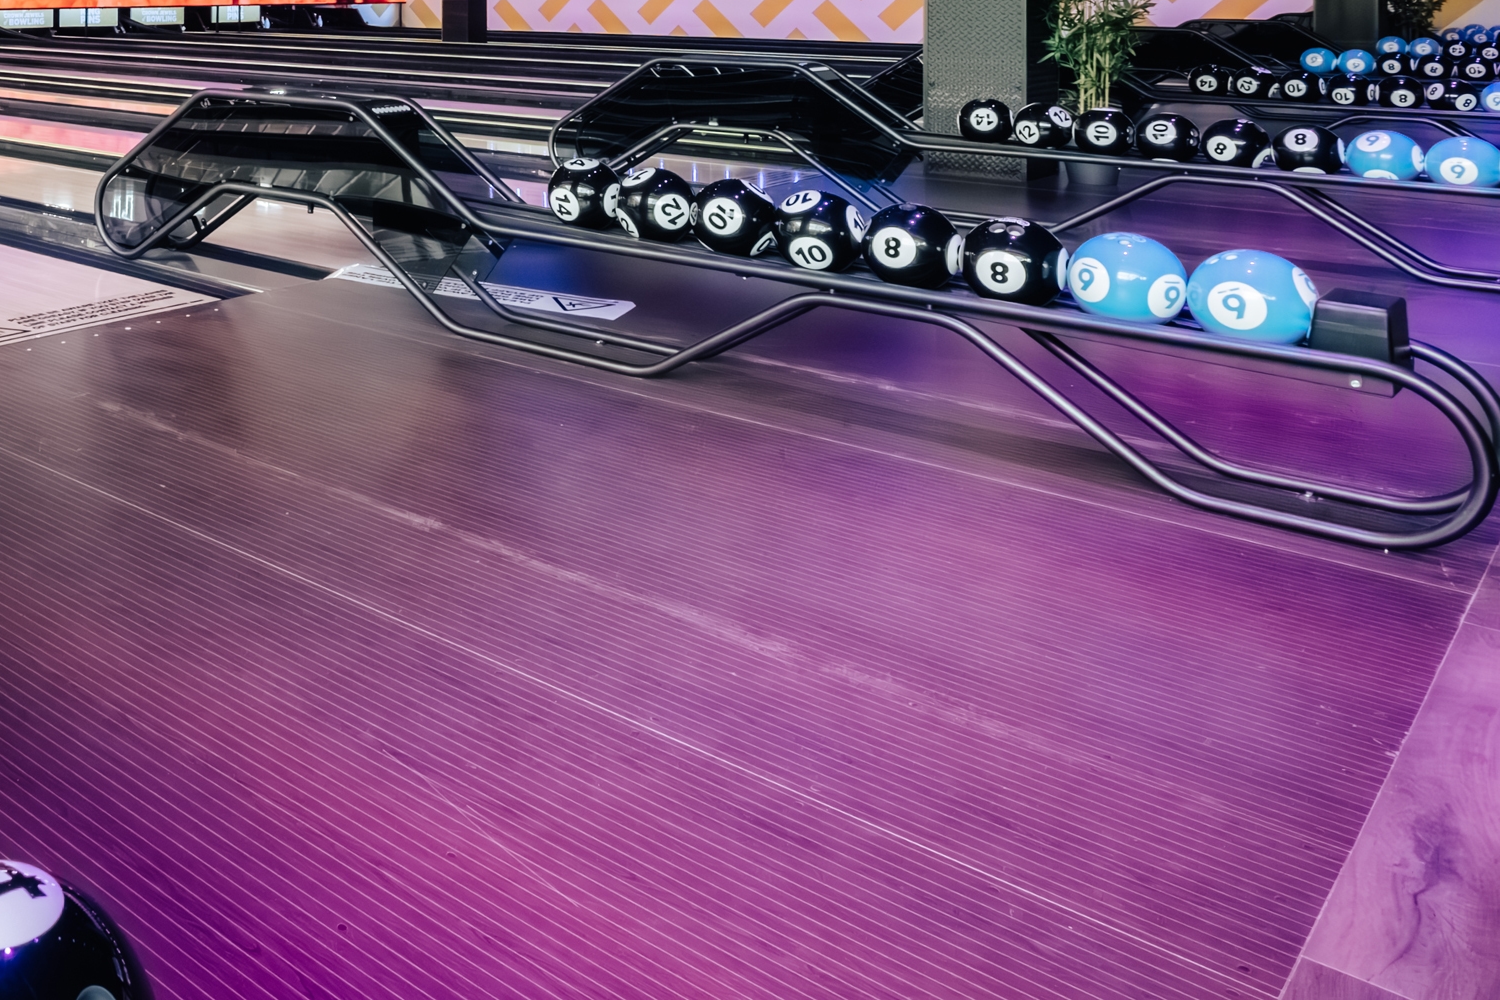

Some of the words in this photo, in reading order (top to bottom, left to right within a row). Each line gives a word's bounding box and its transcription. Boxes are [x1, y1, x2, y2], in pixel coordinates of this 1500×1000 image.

[8, 17, 45, 26] BOWLING
[1199, 79, 1214, 89] 14
[1240, 80, 1254, 91] 12
[1287, 83, 1303, 93] 10
[1334, 92, 1350, 101] 10
[1399, 94, 1408, 103] 8
[1430, 87, 1438, 96] 8
[1462, 98, 1472, 107] 8
[1053, 109, 1070, 123] 12
[1019, 125, 1036, 140] 12
[1094, 124, 1110, 142] 10
[1152, 123, 1169, 140] 10
[1294, 133, 1307, 145] 8
[1214, 142, 1227, 156] 8
[556, 194, 572, 217] 14
[785, 192, 813, 207] 10
[661, 198, 685, 226] 12
[708, 204, 735, 230] 10
[795, 244, 827, 264] 10
[884, 237, 901, 258] 8
[990, 261, 1009, 284] 8
